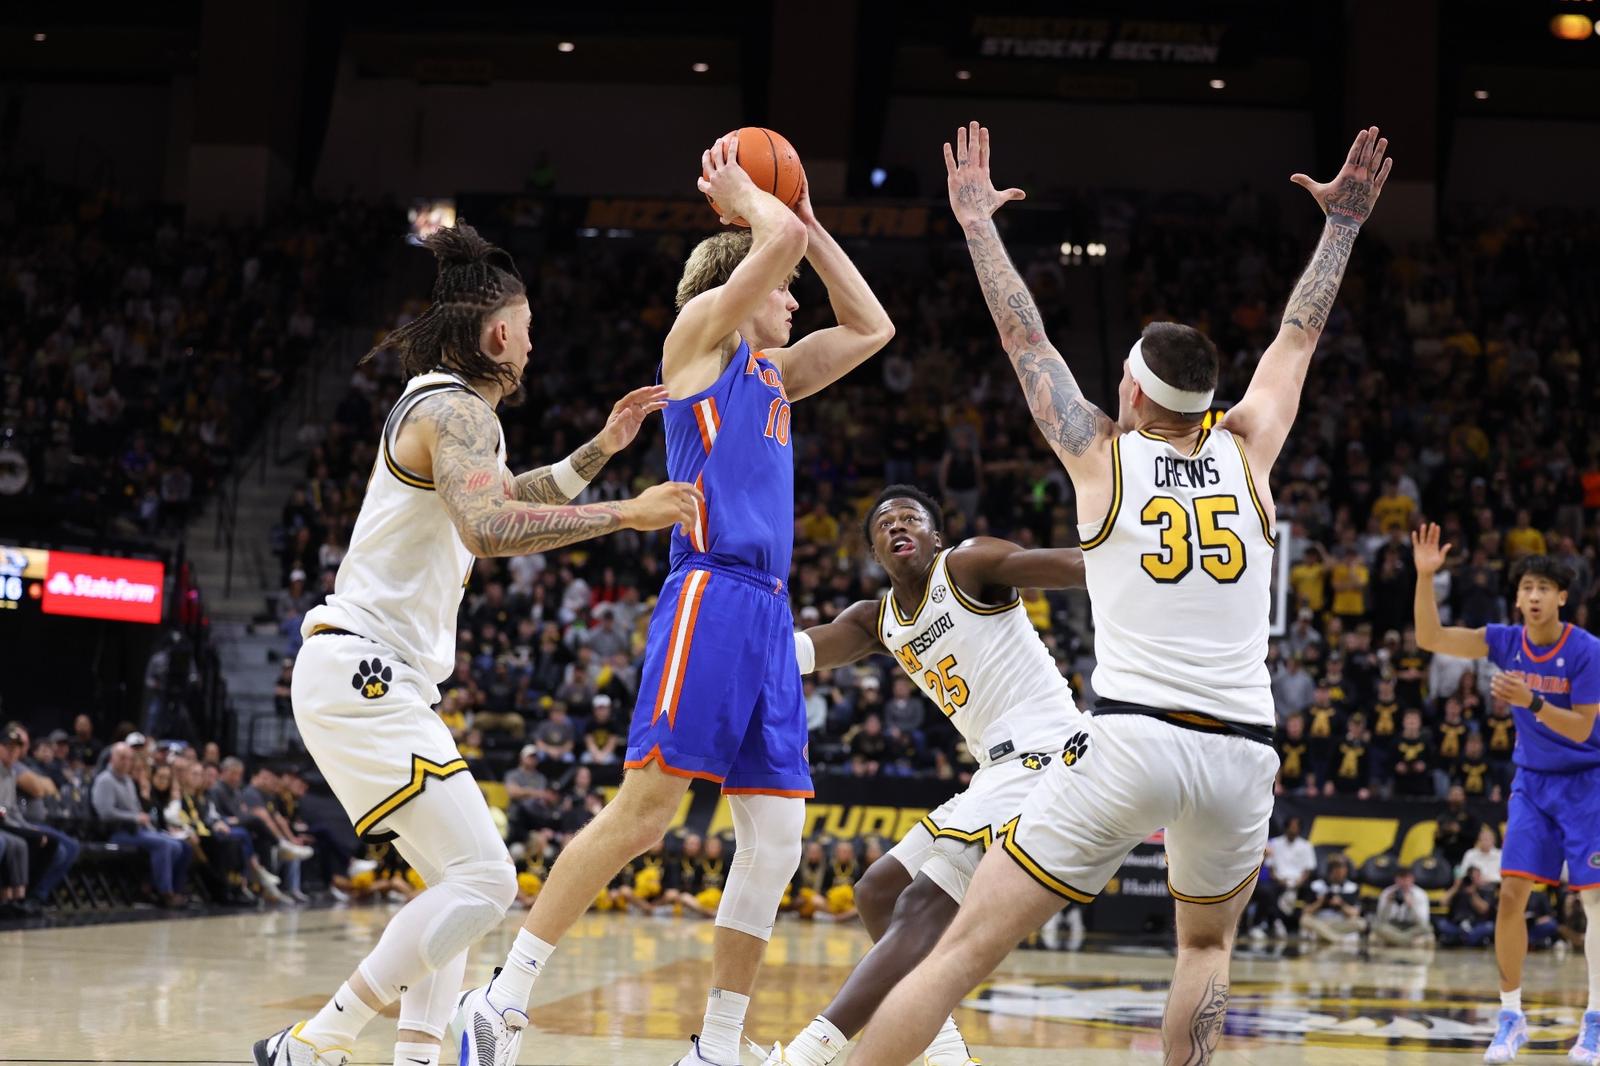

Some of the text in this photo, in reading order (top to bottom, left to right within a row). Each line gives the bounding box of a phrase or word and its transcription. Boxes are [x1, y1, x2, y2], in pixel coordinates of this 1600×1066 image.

[980, 37, 1220, 64] STUDENT SECTION
[763, 397, 791, 447] 10
[1154, 455, 1221, 489] CREWS
[1140, 494, 1247, 585] 35
[894, 611, 955, 675] MISSOURI
[365, 681, 385, 698] M
[923, 653, 971, 719] 25
